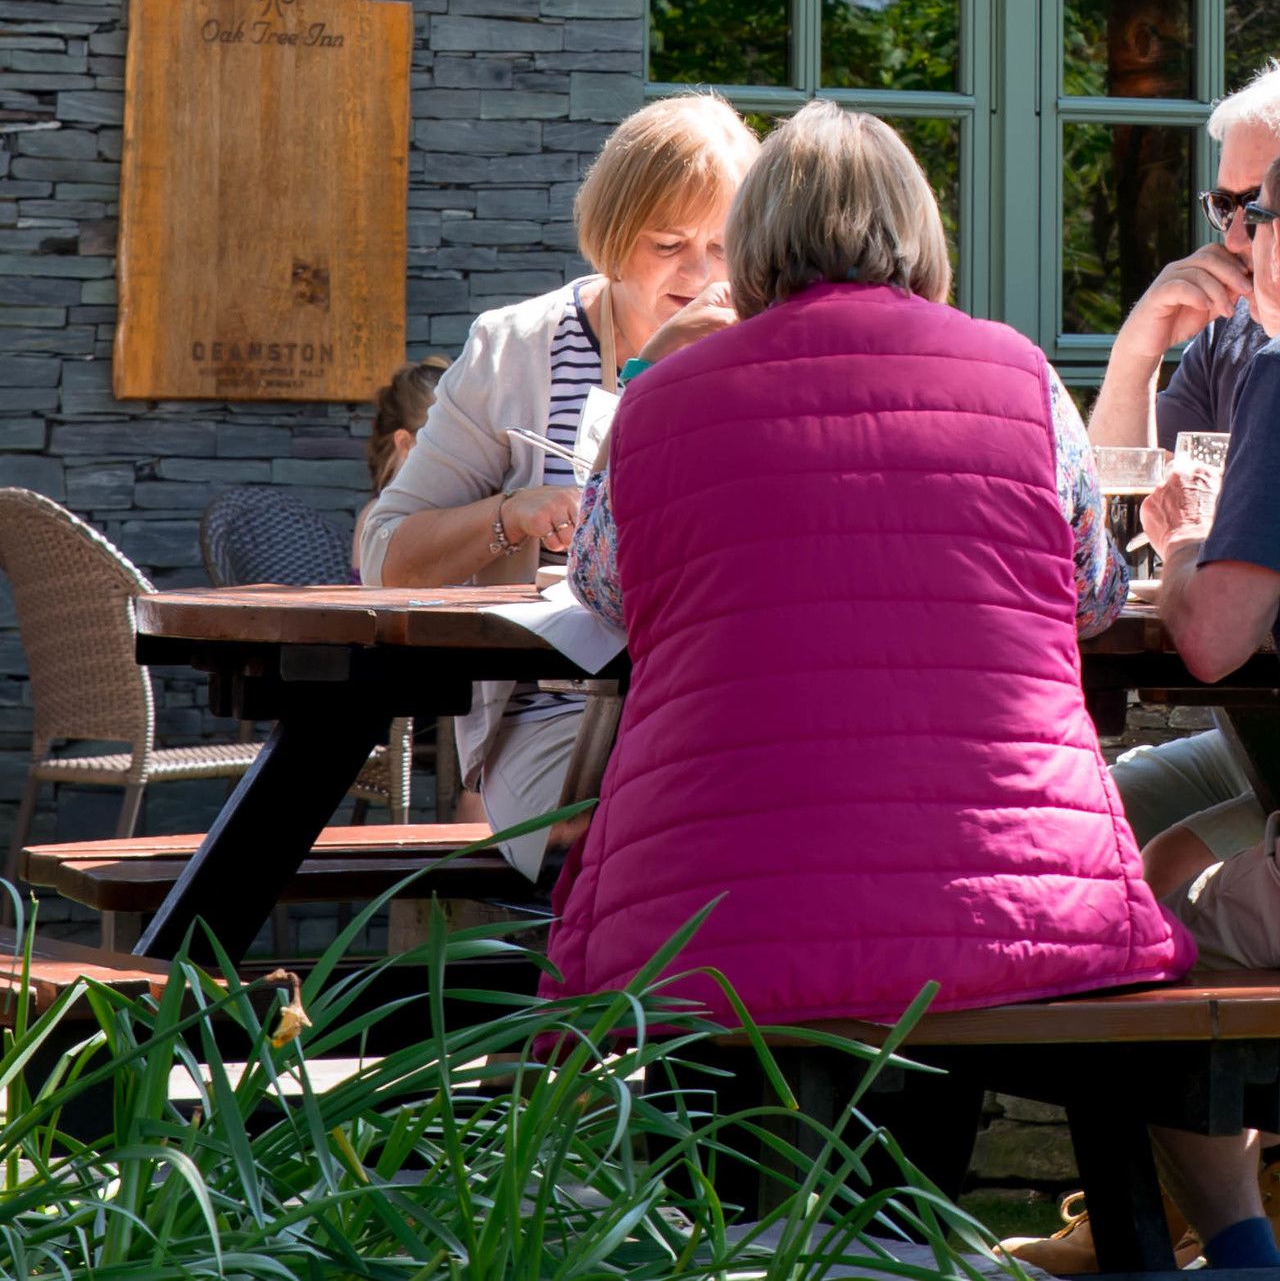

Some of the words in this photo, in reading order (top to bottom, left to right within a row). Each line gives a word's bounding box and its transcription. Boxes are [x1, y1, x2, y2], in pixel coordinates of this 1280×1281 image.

[202, 19, 245, 43] Oak
[251, 21, 299, 46] Tree
[303, 22, 345, 47] Inn
[191, 341, 334, 363] DEANSTON
